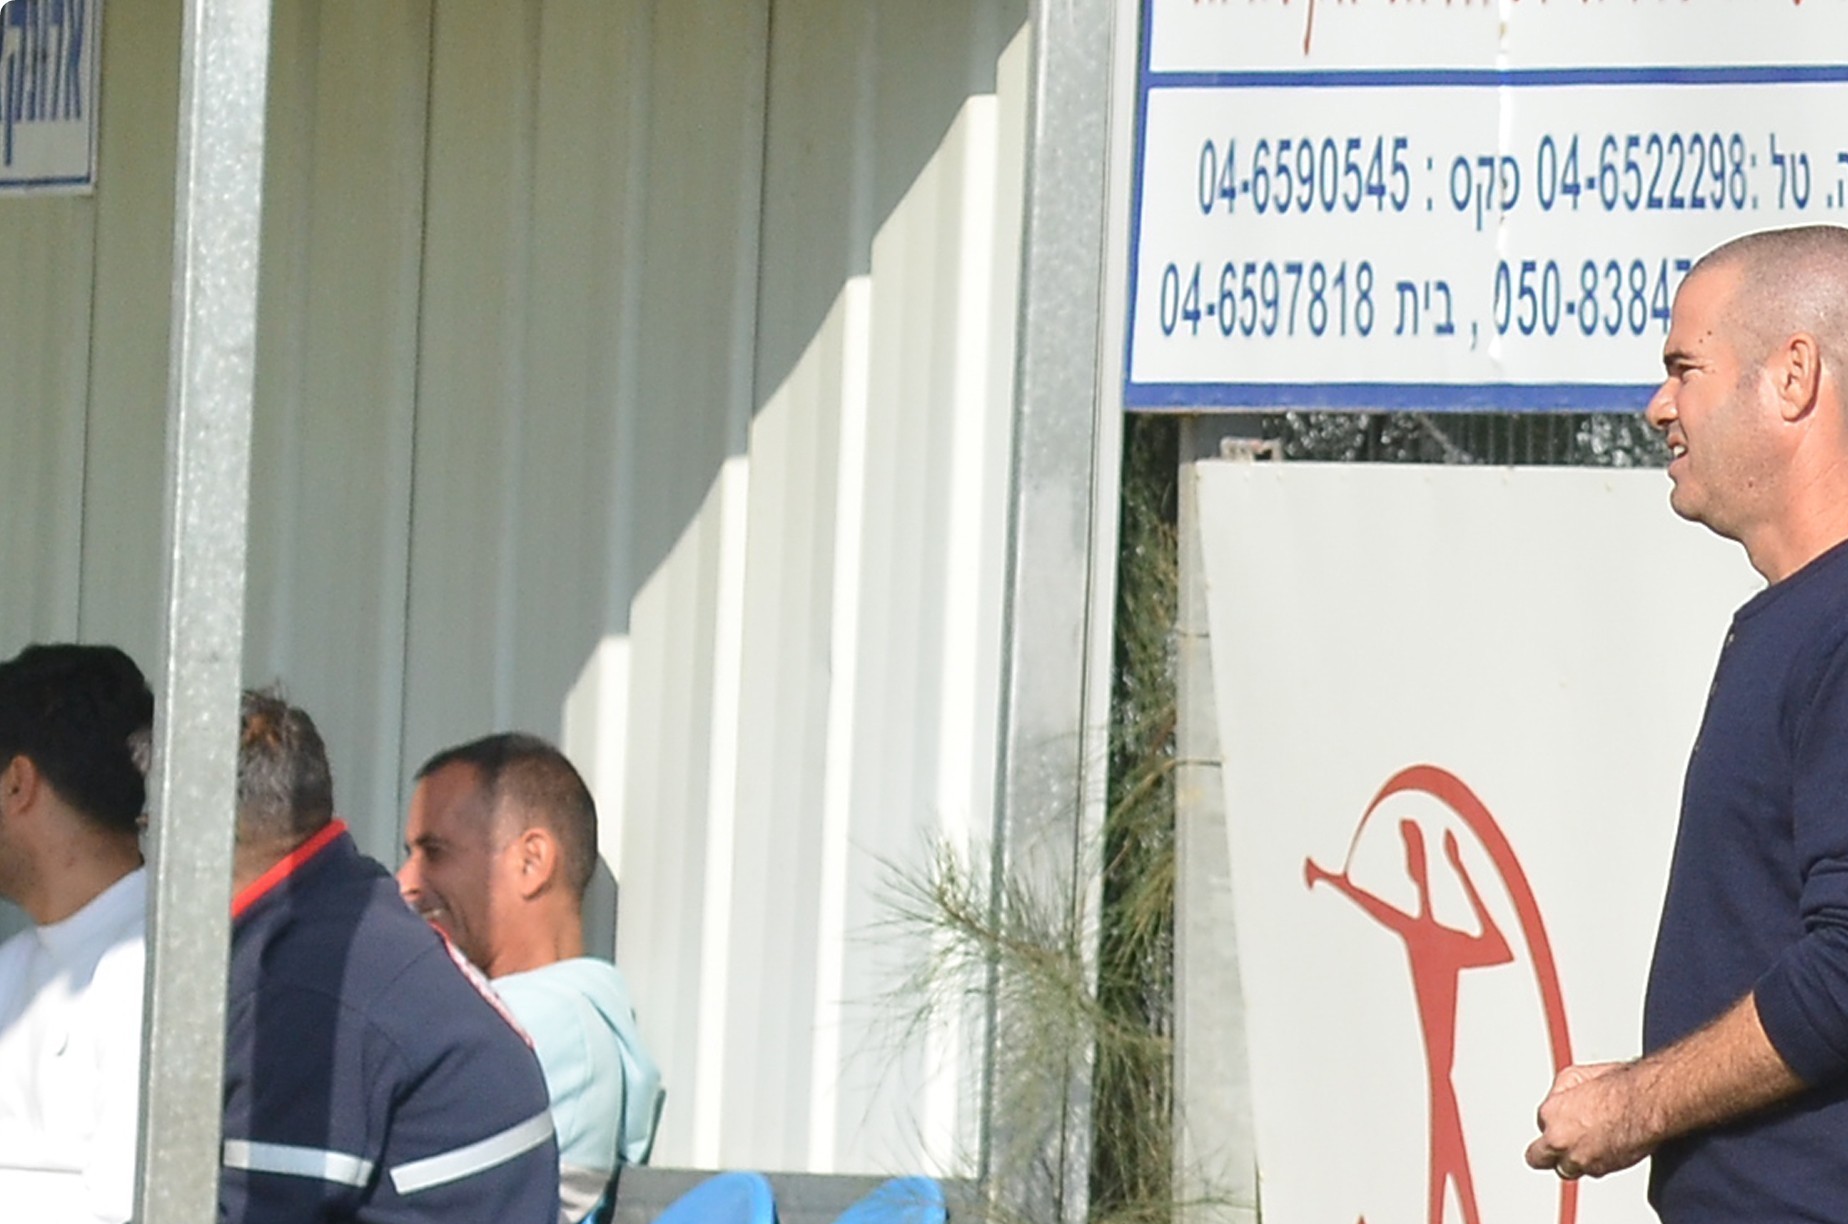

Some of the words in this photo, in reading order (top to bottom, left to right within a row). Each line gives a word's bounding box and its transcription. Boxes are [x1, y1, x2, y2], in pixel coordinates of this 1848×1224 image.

[1200, 136, 1412, 216] 04-6590545
[1160, 260, 1376, 338] 04-6597818
[1395, 279, 1458, 337] בית
